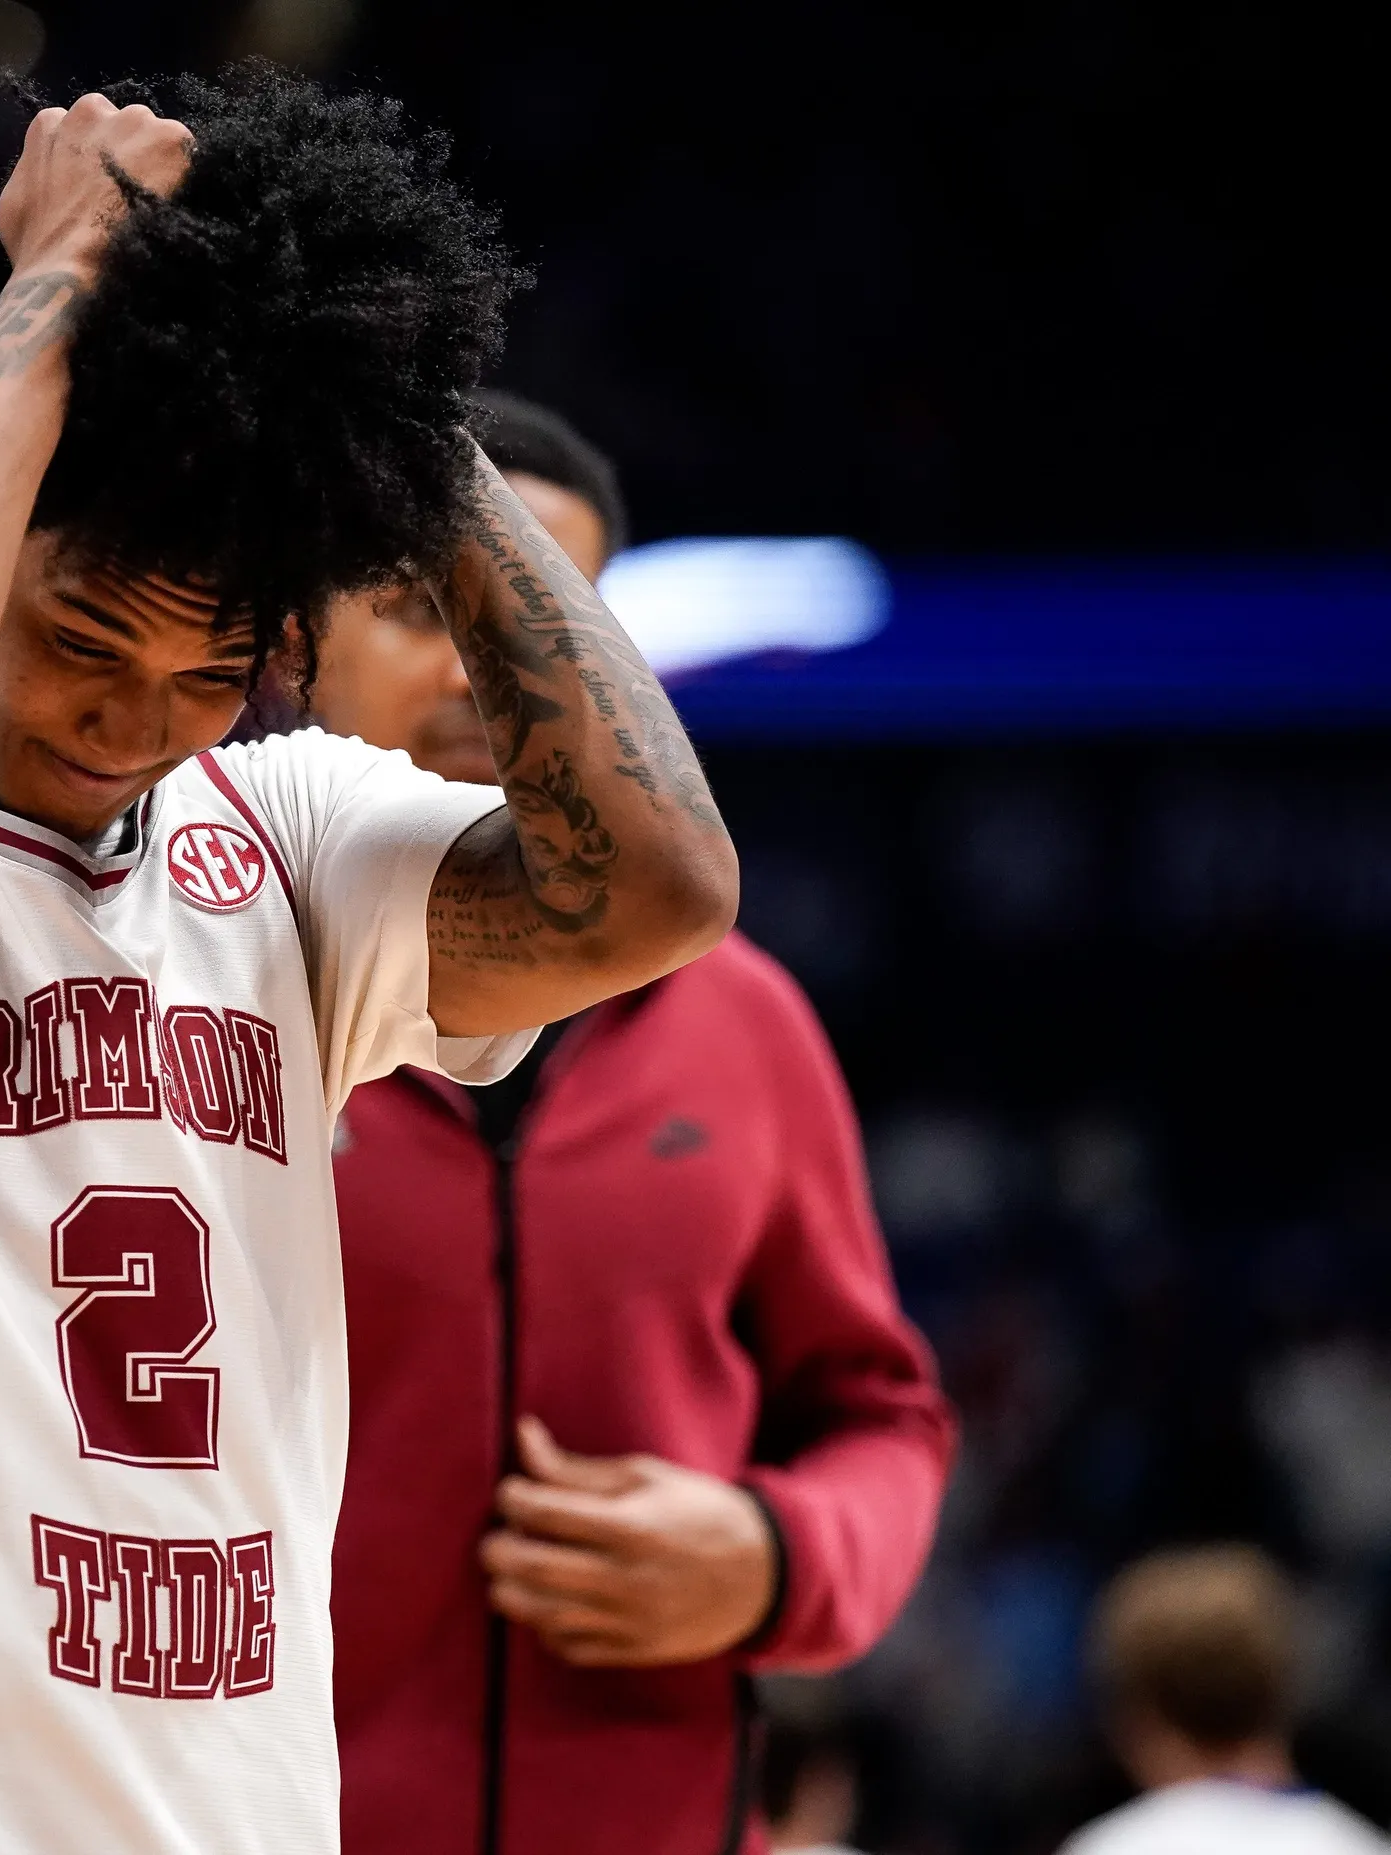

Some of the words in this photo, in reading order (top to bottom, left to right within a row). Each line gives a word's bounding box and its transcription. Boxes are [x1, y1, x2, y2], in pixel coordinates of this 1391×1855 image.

[170, 827, 264, 902] SEC
[50, 1184, 221, 1472] 2
[30, 1512, 277, 1700] TIDE
